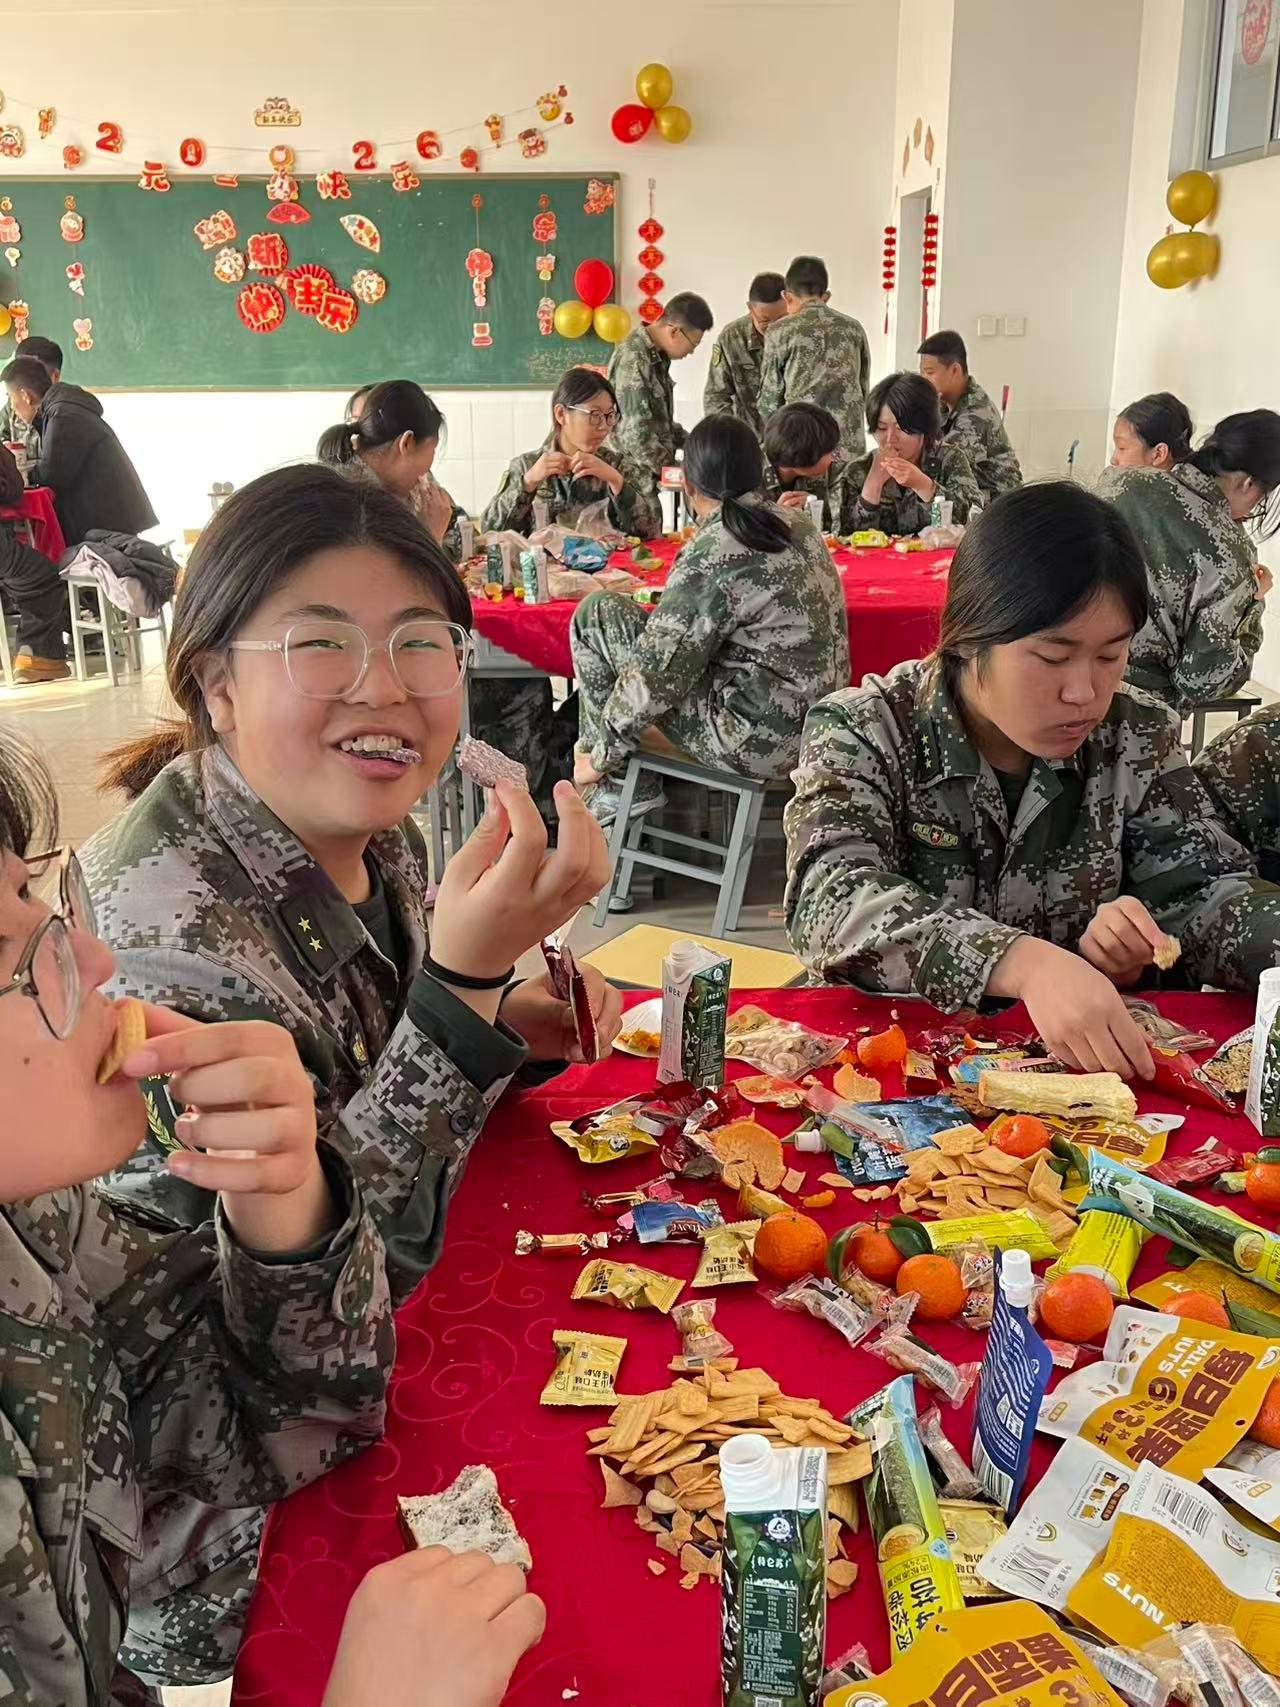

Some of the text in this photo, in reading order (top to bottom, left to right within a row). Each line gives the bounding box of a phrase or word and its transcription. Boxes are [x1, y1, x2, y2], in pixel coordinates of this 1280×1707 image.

[1177, 1340, 1216, 1377] DAILY
[1126, 1348, 1255, 1468] 每日坚果
[1103, 1571, 1165, 1624] NUTS
[908, 1632, 1082, 1707] 日坚果
